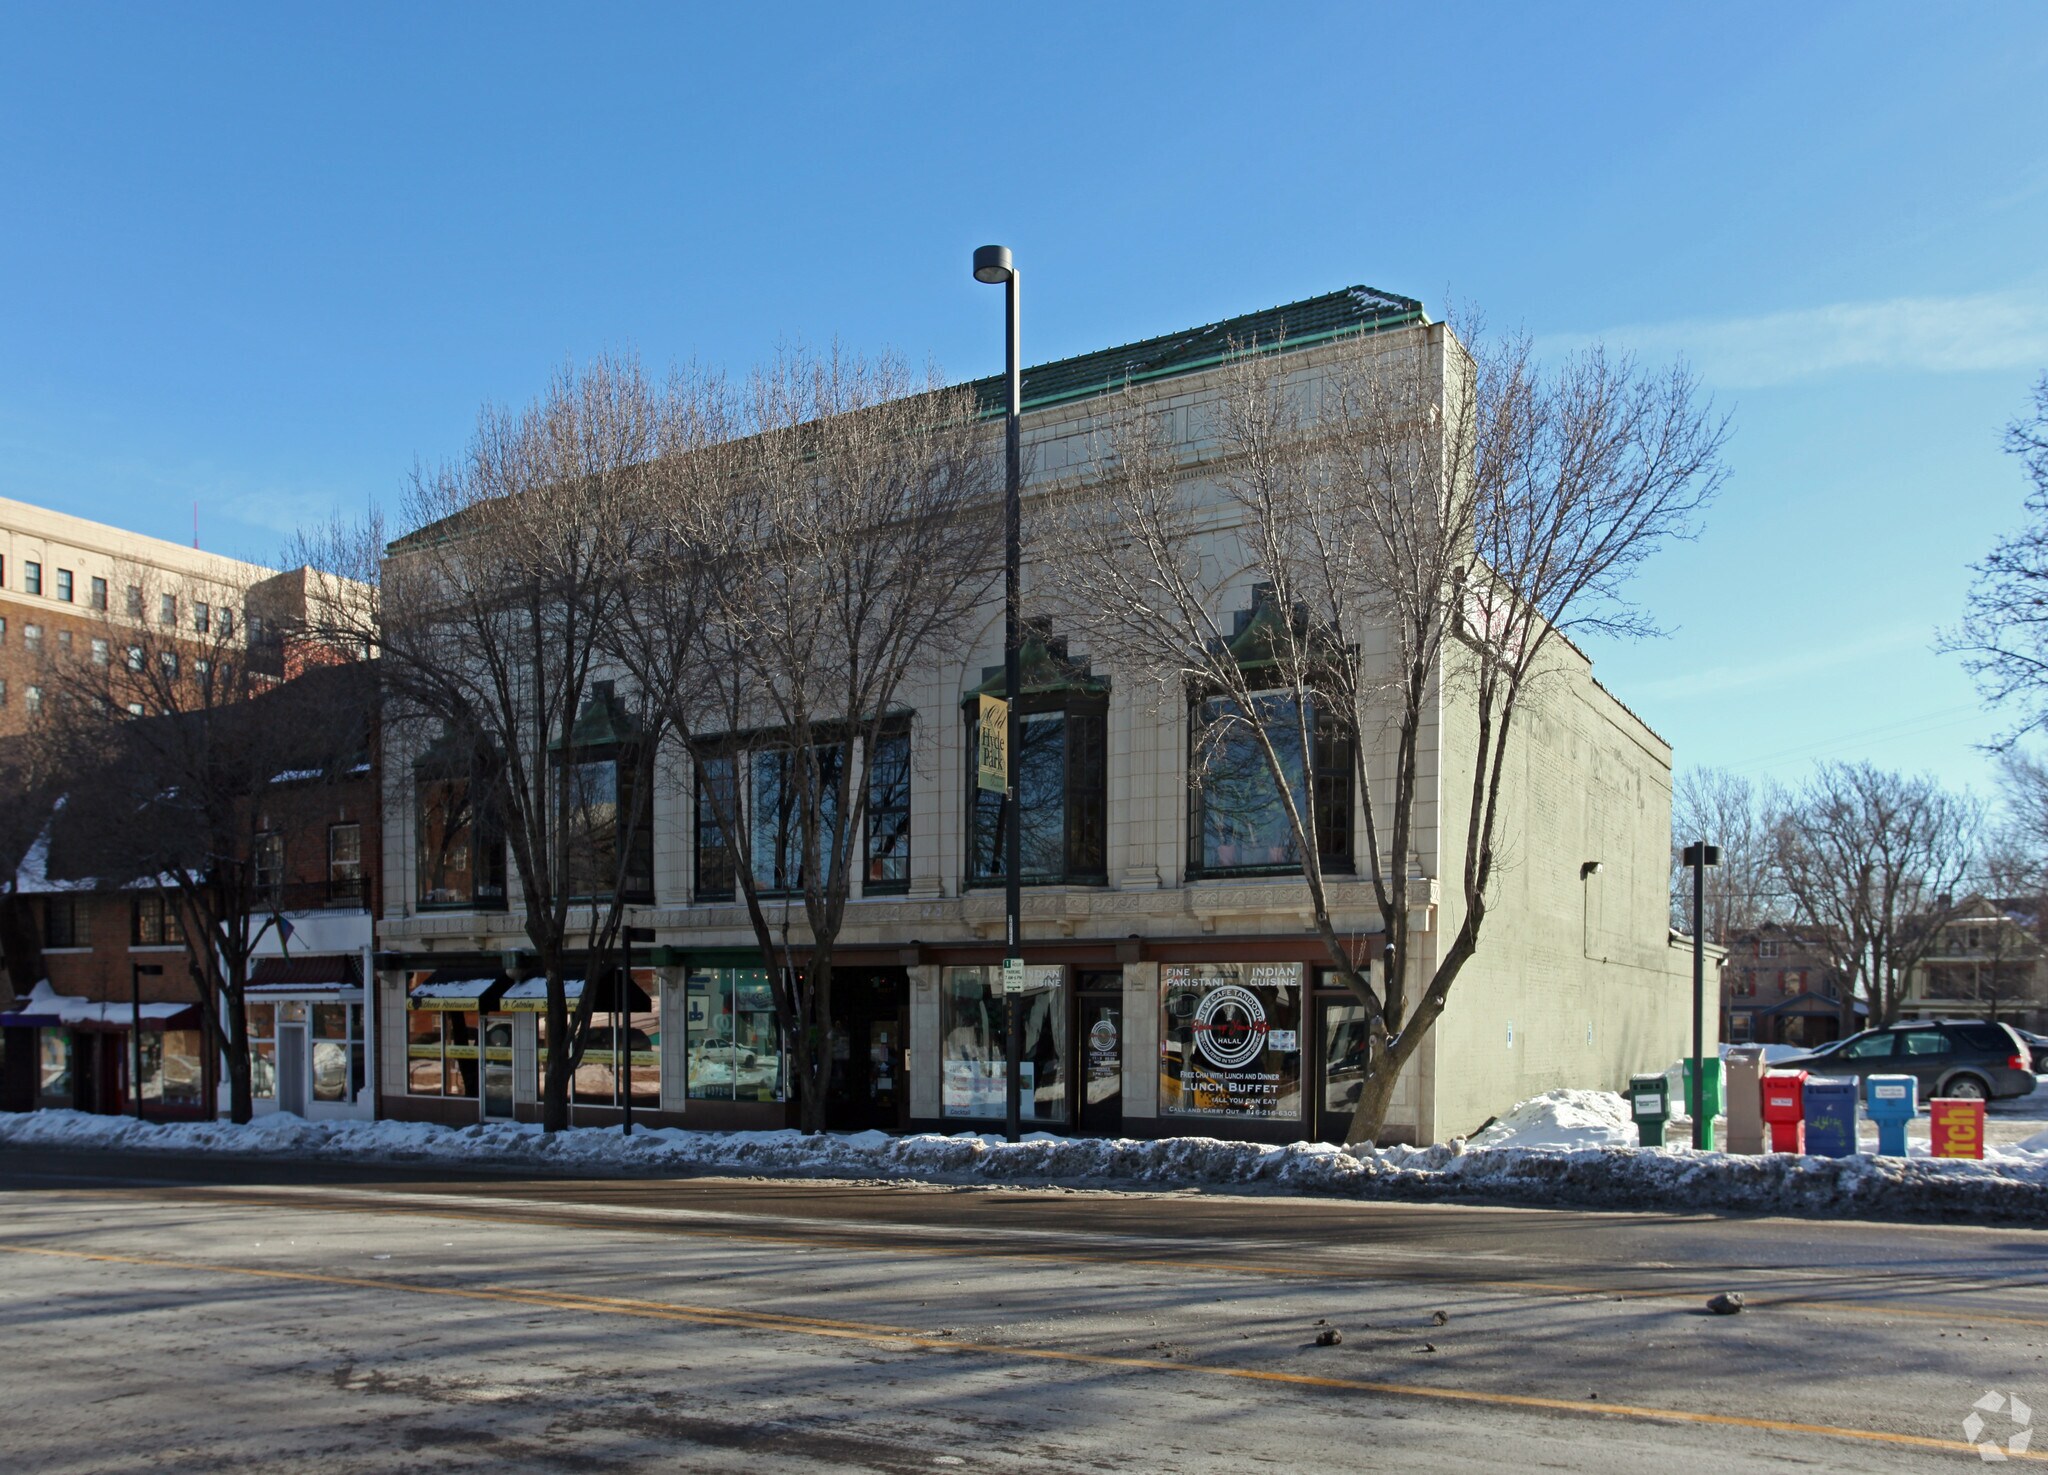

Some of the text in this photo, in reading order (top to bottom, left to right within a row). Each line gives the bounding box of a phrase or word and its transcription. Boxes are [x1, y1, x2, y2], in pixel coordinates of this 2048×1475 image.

[987, 703, 1006, 729] Old
[983, 727, 1004, 751] Hyde
[983, 748, 1003, 770] Park
[1024, 970, 1060, 979] INDIAN
[1252, 967, 1295, 976] INDIAN
[1166, 977, 1224, 987] PAKISTANI
[1250, 978, 1297, 986] CUISINE
[442, 999, 477, 1009] Restaurant
[511, 1000, 535, 1012] Catering
[1199, 989, 1263, 1022] NEW CAFE TANDOOR
[1180, 1070, 1194, 1078] FREE
[1224, 1072, 1244, 1080] LUNCH
[1257, 1072, 1280, 1081] DINNER
[1182, 1082, 1278, 1093] LUNCH BUFFET
